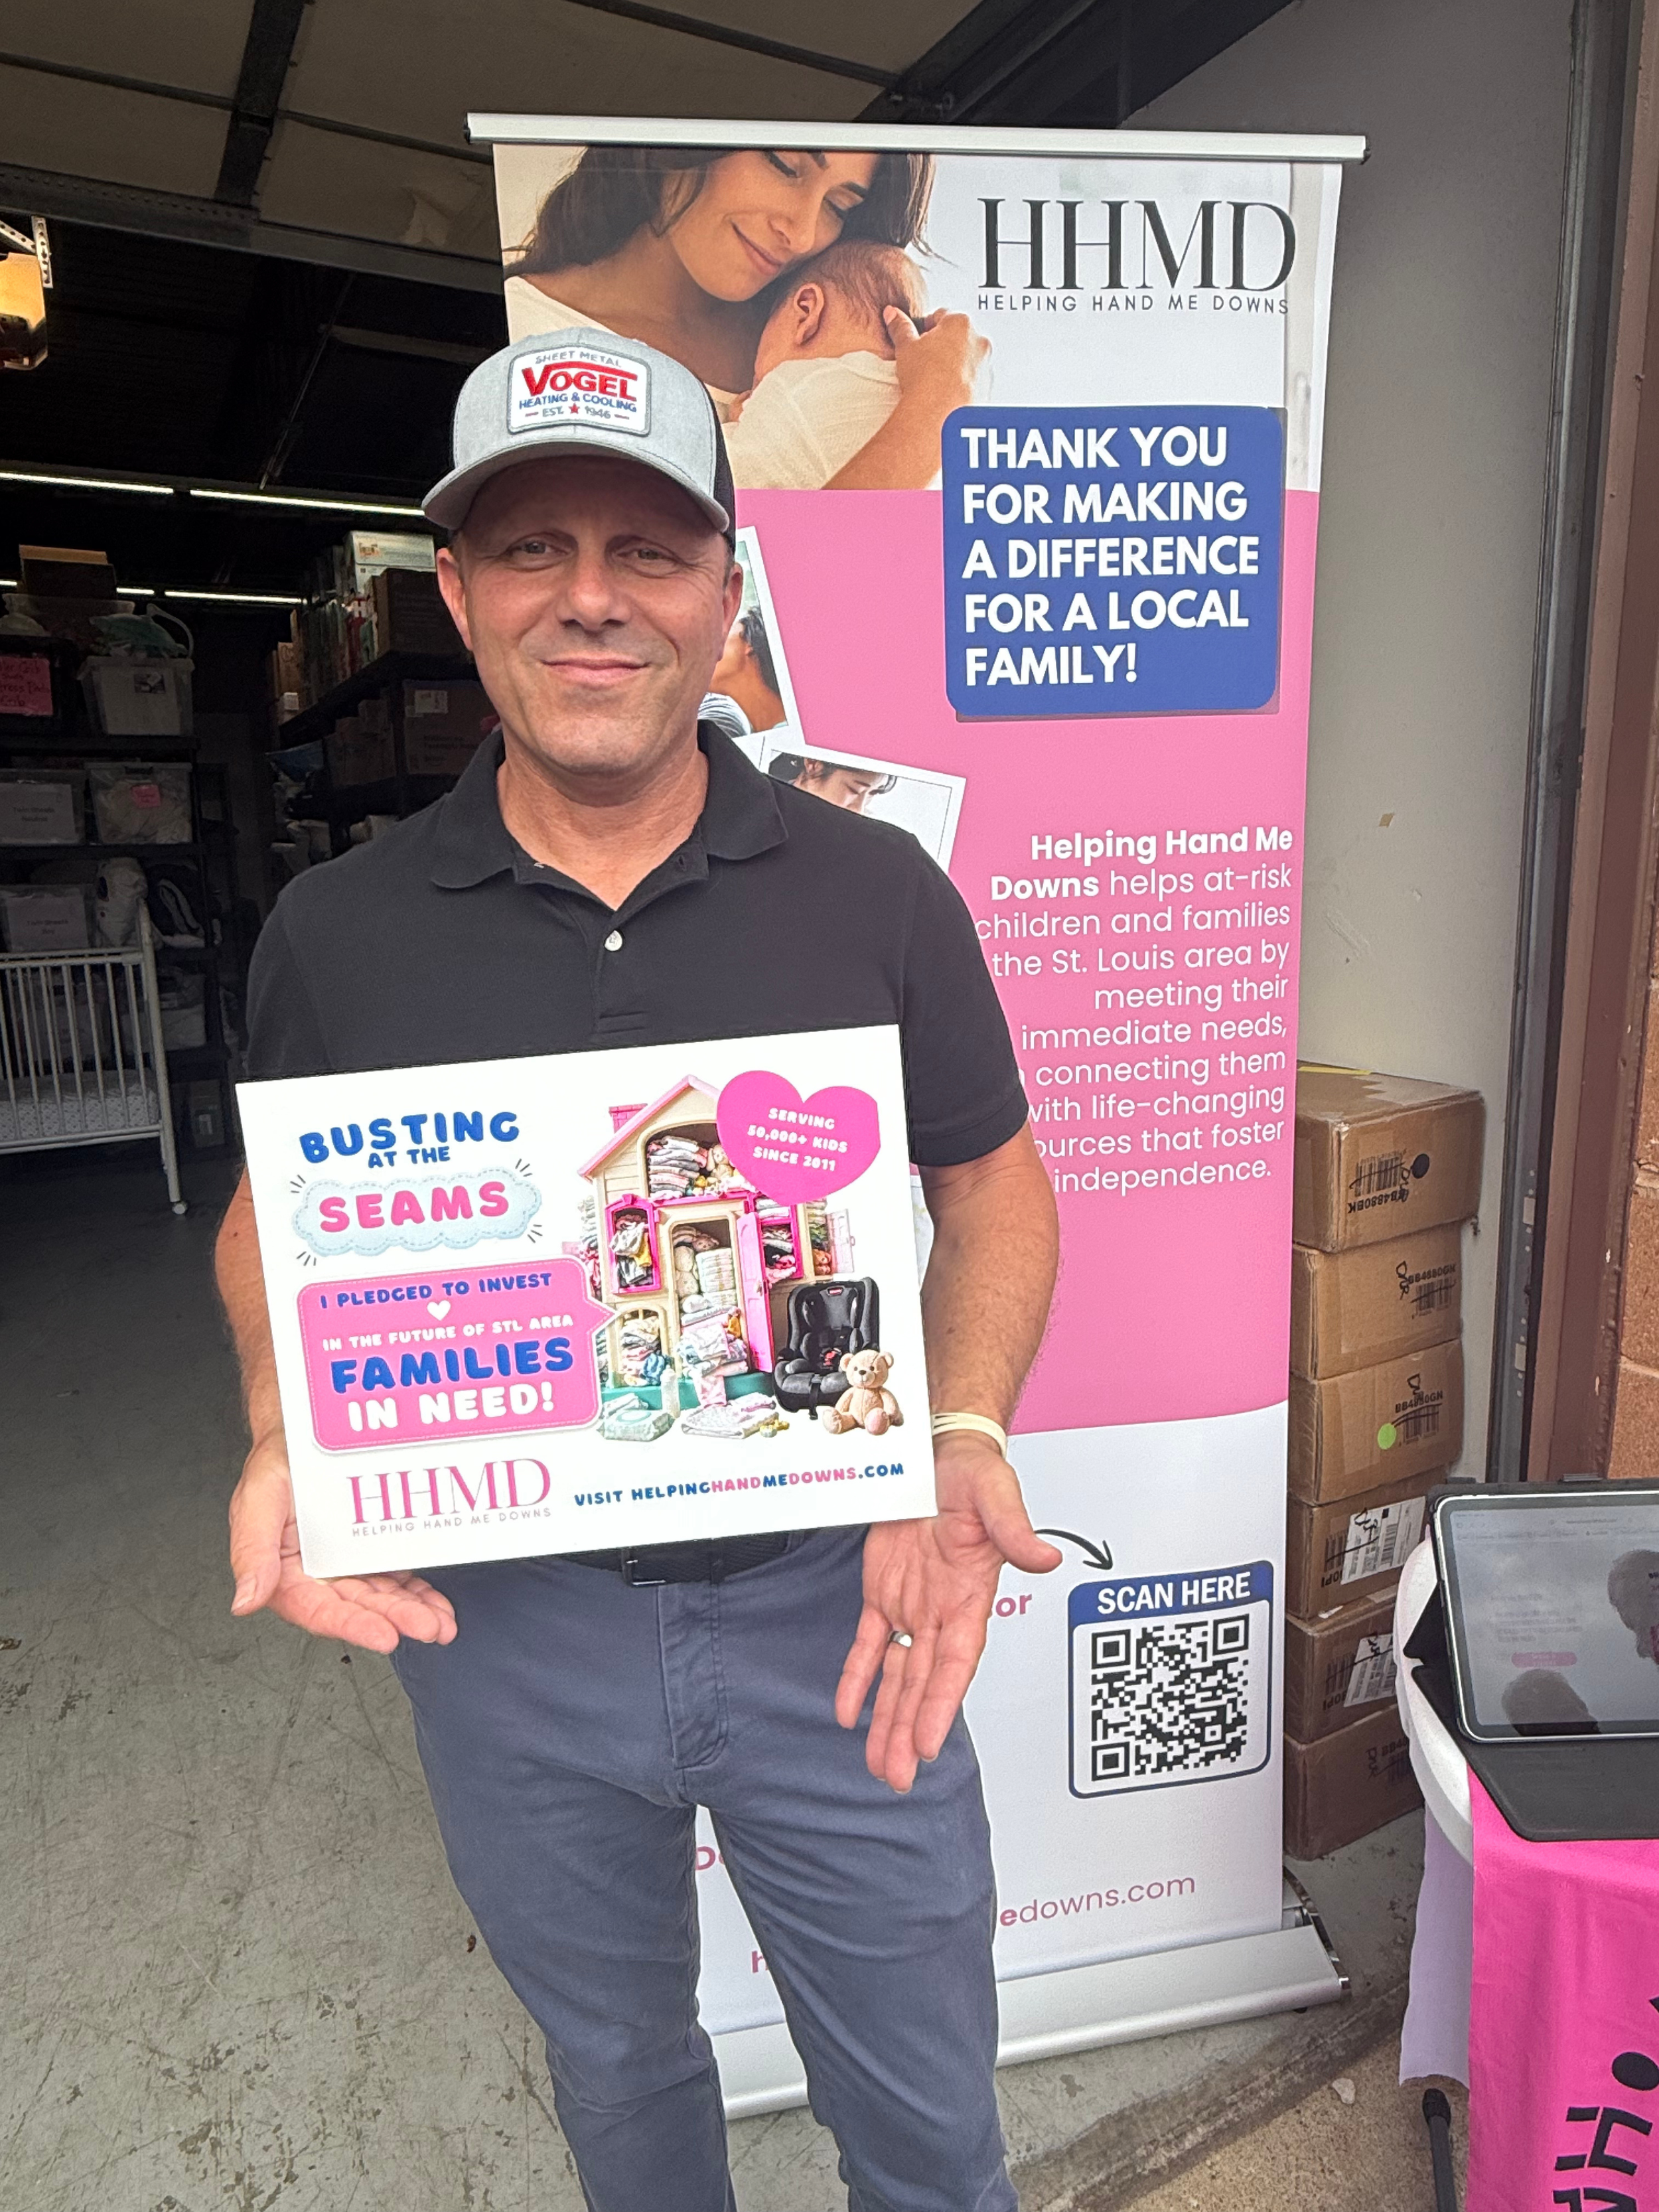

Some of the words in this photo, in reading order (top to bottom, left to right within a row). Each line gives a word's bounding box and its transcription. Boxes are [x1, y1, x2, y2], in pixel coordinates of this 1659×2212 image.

[977, 198, 1296, 291] HHMD
[978, 295, 1077, 312] HELPING
[1093, 295, 1154, 311] HAND
[1169, 295, 1198, 311] ME
[1214, 296, 1289, 315] DOWNS
[535, 350, 574, 364] SHEET
[579, 351, 621, 368] METAL
[522, 362, 638, 402] VOGEL
[519, 394, 568, 409] HEATING
[571, 392, 580, 402] &
[583, 393, 637, 413] COOLING
[585, 406, 611, 419] 1946
[961, 427, 1119, 469] THANK
[1130, 425, 1227, 467] YOU
[964, 484, 1053, 524] FOR
[1063, 481, 1248, 524] MAKING
[962, 540, 997, 579] A
[1009, 536, 1259, 578] DIFFERENCE
[965, 593, 1053, 633] FOR
[1062, 593, 1097, 632] A
[1109, 589, 1249, 630] LOCAL
[966, 643, 1137, 686] FAMILY!
[1032, 830, 1157, 866] Helping
[1166, 827, 1248, 855] Hand
[1256, 826, 1293, 851] Me
[991, 875, 1099, 901] Downs
[1110, 869, 1194, 902] helps
[1204, 863, 1292, 891] at-risk
[975, 911, 1100, 940] children
[1112, 907, 1173, 934] and
[1183, 902, 1291, 931] families
[992, 951, 1043, 976] the
[1052, 949, 1088, 974] St.
[1098, 945, 1175, 972] Louis
[1185, 943, 1252, 968] area
[1262, 939, 1290, 969] by
[1095, 982, 1222, 1011] meeting
[1232, 976, 1289, 1002] their
[1021, 1019, 1191, 1050] immediate
[1202, 1013, 1287, 1041] needs,
[1035, 1054, 1210, 1086] connecting
[1220, 1049, 1286, 1076] them
[768, 1108, 835, 1130] SERVING
[1092, 1084, 1285, 1121] life-changing
[299, 1110, 520, 1163] BUSTING
[747, 1125, 807, 1144] 50,000+
[812, 1136, 848, 1153] KIDS
[1141, 1128, 1202, 1152] that
[1212, 1119, 1285, 1148] foster
[368, 1150, 397, 1168] AT
[407, 1145, 451, 1164] THE
[753, 1146, 799, 1164] SINCE
[803, 1155, 835, 1171] 2011
[1054, 1159, 1271, 1196] independence.
[319, 1181, 509, 1232] SEAMS
[321, 1295, 328, 1309] I
[337, 1286, 433, 1307] PLEDGED
[443, 1281, 470, 1297] TO
[479, 1273, 552, 1293] INVEST
[323, 1338, 342, 1351] IN
[349, 1333, 382, 1349] THE
[389, 1326, 457, 1344] FUTURE
[463, 1323, 485, 1337] OF
[492, 1320, 523, 1334] STL
[529, 1314, 574, 1330] AREA
[330, 1337, 574, 1394] FAMILIES
[348, 1396, 399, 1432] IN
[419, 1381, 555, 1425] NEED!
[346, 1458, 551, 1524] HHMD
[574, 1490, 622, 1506] VISIT
[632, 1463, 904, 1501] HELPINGHANDMEDOWNS.COM
[352, 1521, 415, 1537] HELPING
[423, 1516, 463, 1529] HAND
[470, 1514, 490, 1524] ME
[499, 1508, 551, 1522] DOWNS
[1098, 1582, 1173, 1615] SCAN
[1182, 1572, 1251, 1603] HERE
